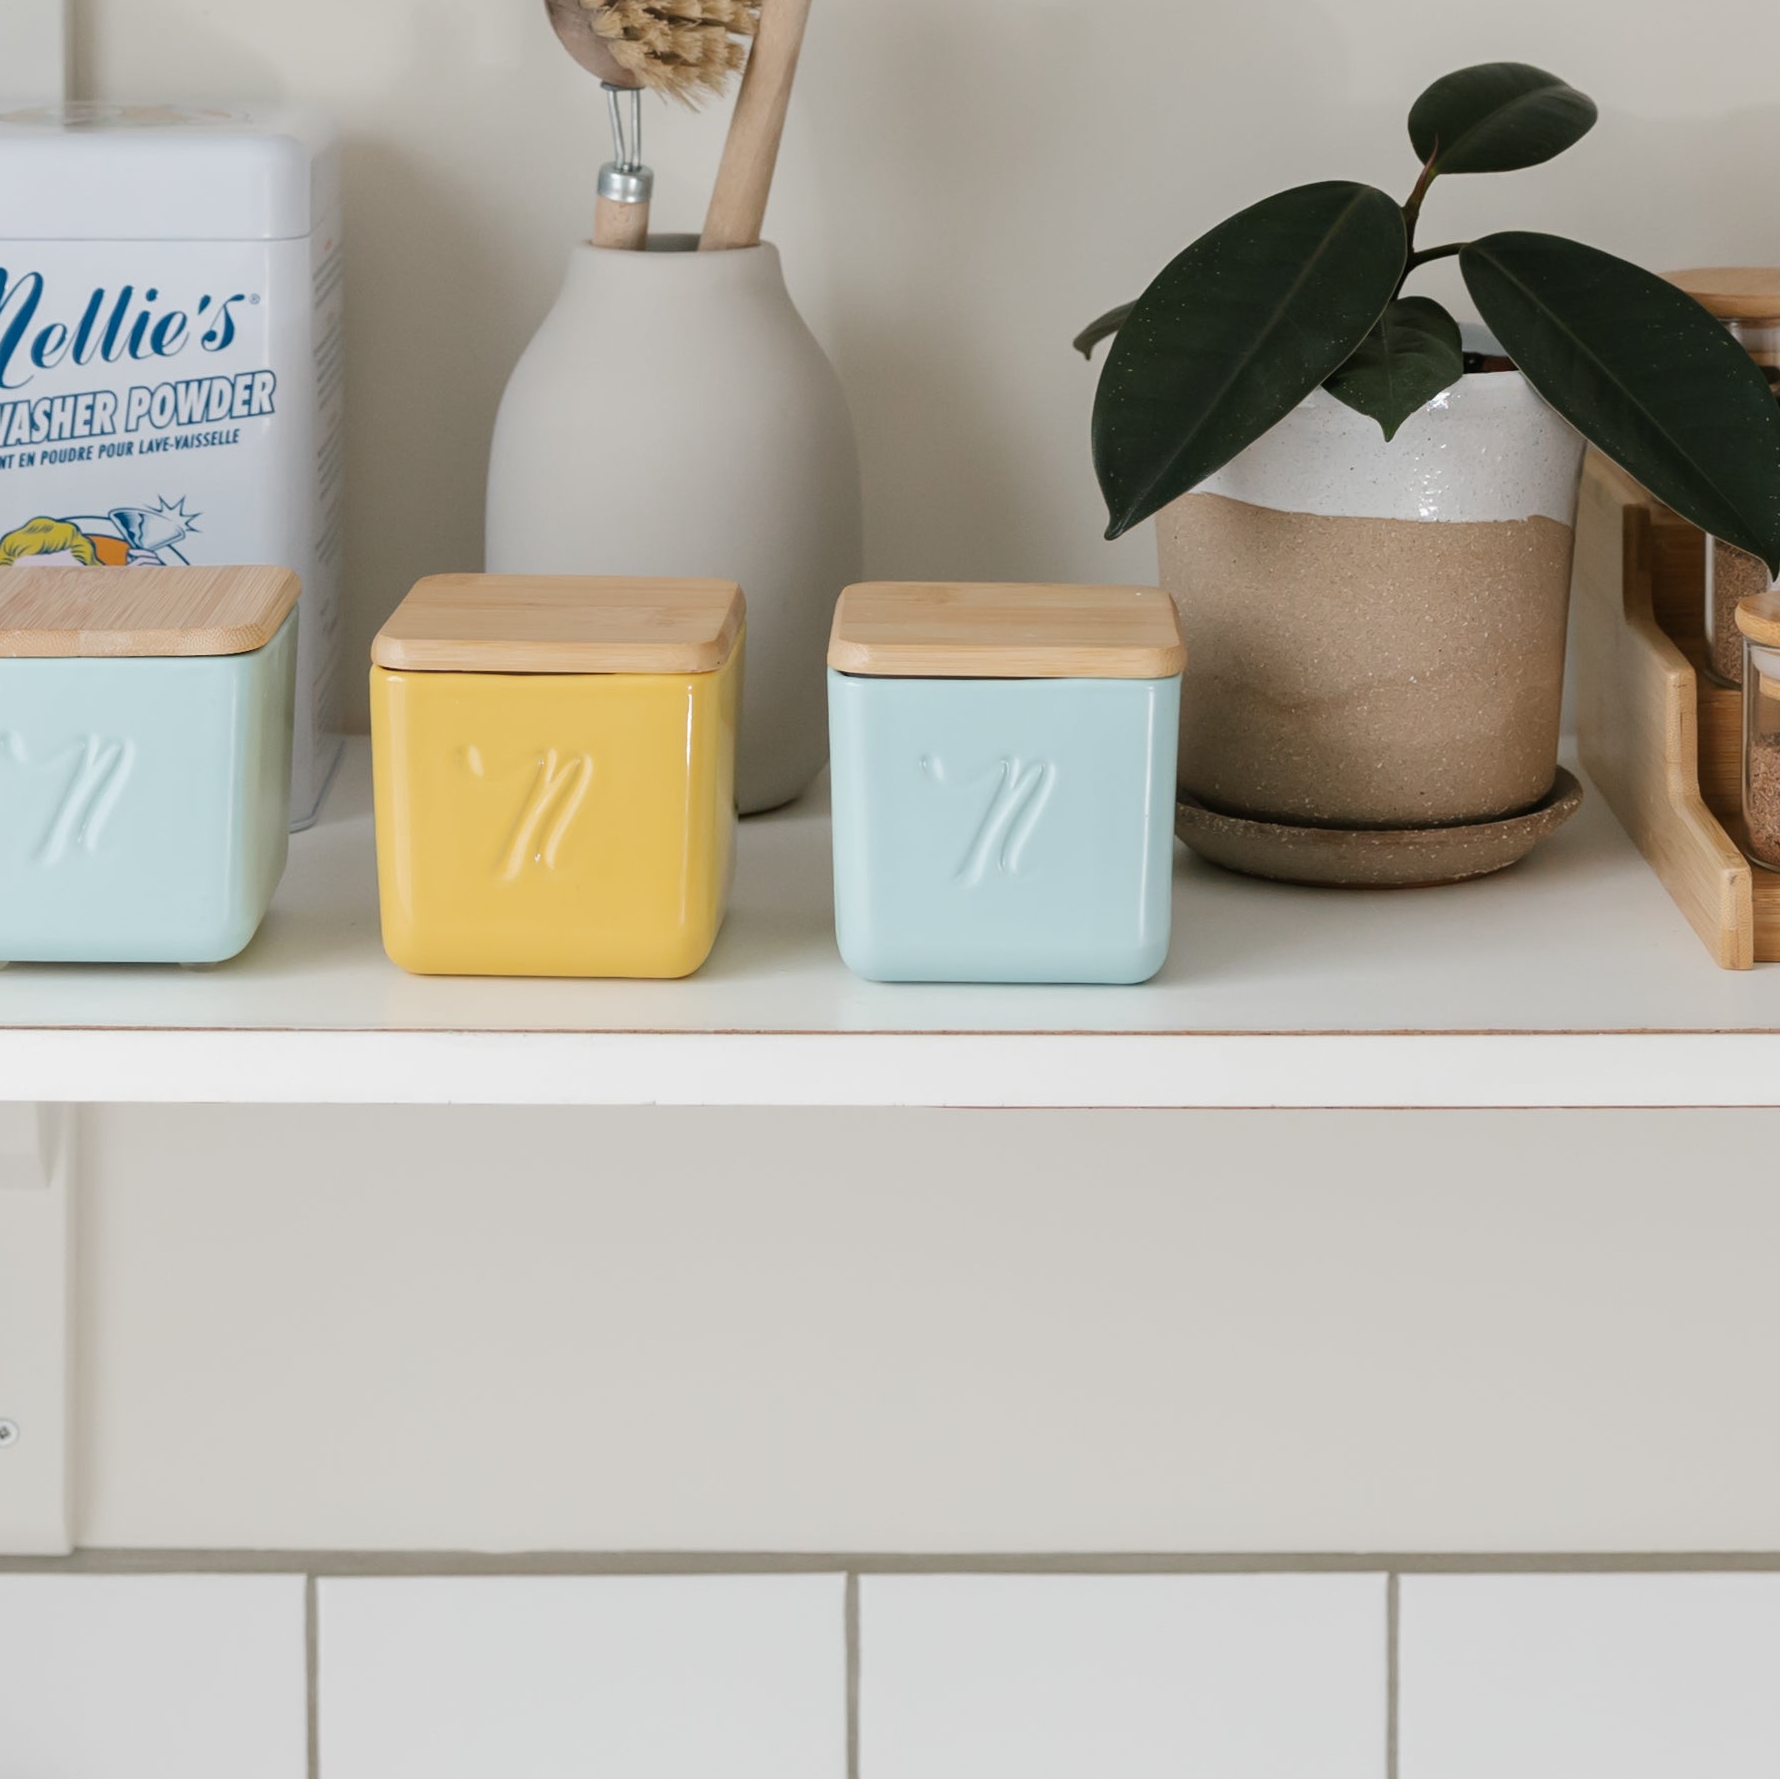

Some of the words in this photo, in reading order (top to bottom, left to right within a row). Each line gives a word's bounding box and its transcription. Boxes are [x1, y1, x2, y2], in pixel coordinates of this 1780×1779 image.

[125, 369, 277, 433] POWDER
[18, 452, 36, 468] EN
[39, 445, 94, 466] POUDRE
[97, 440, 134, 459] POUR
[138, 428, 241, 456] LAVE-VAISSELLE
